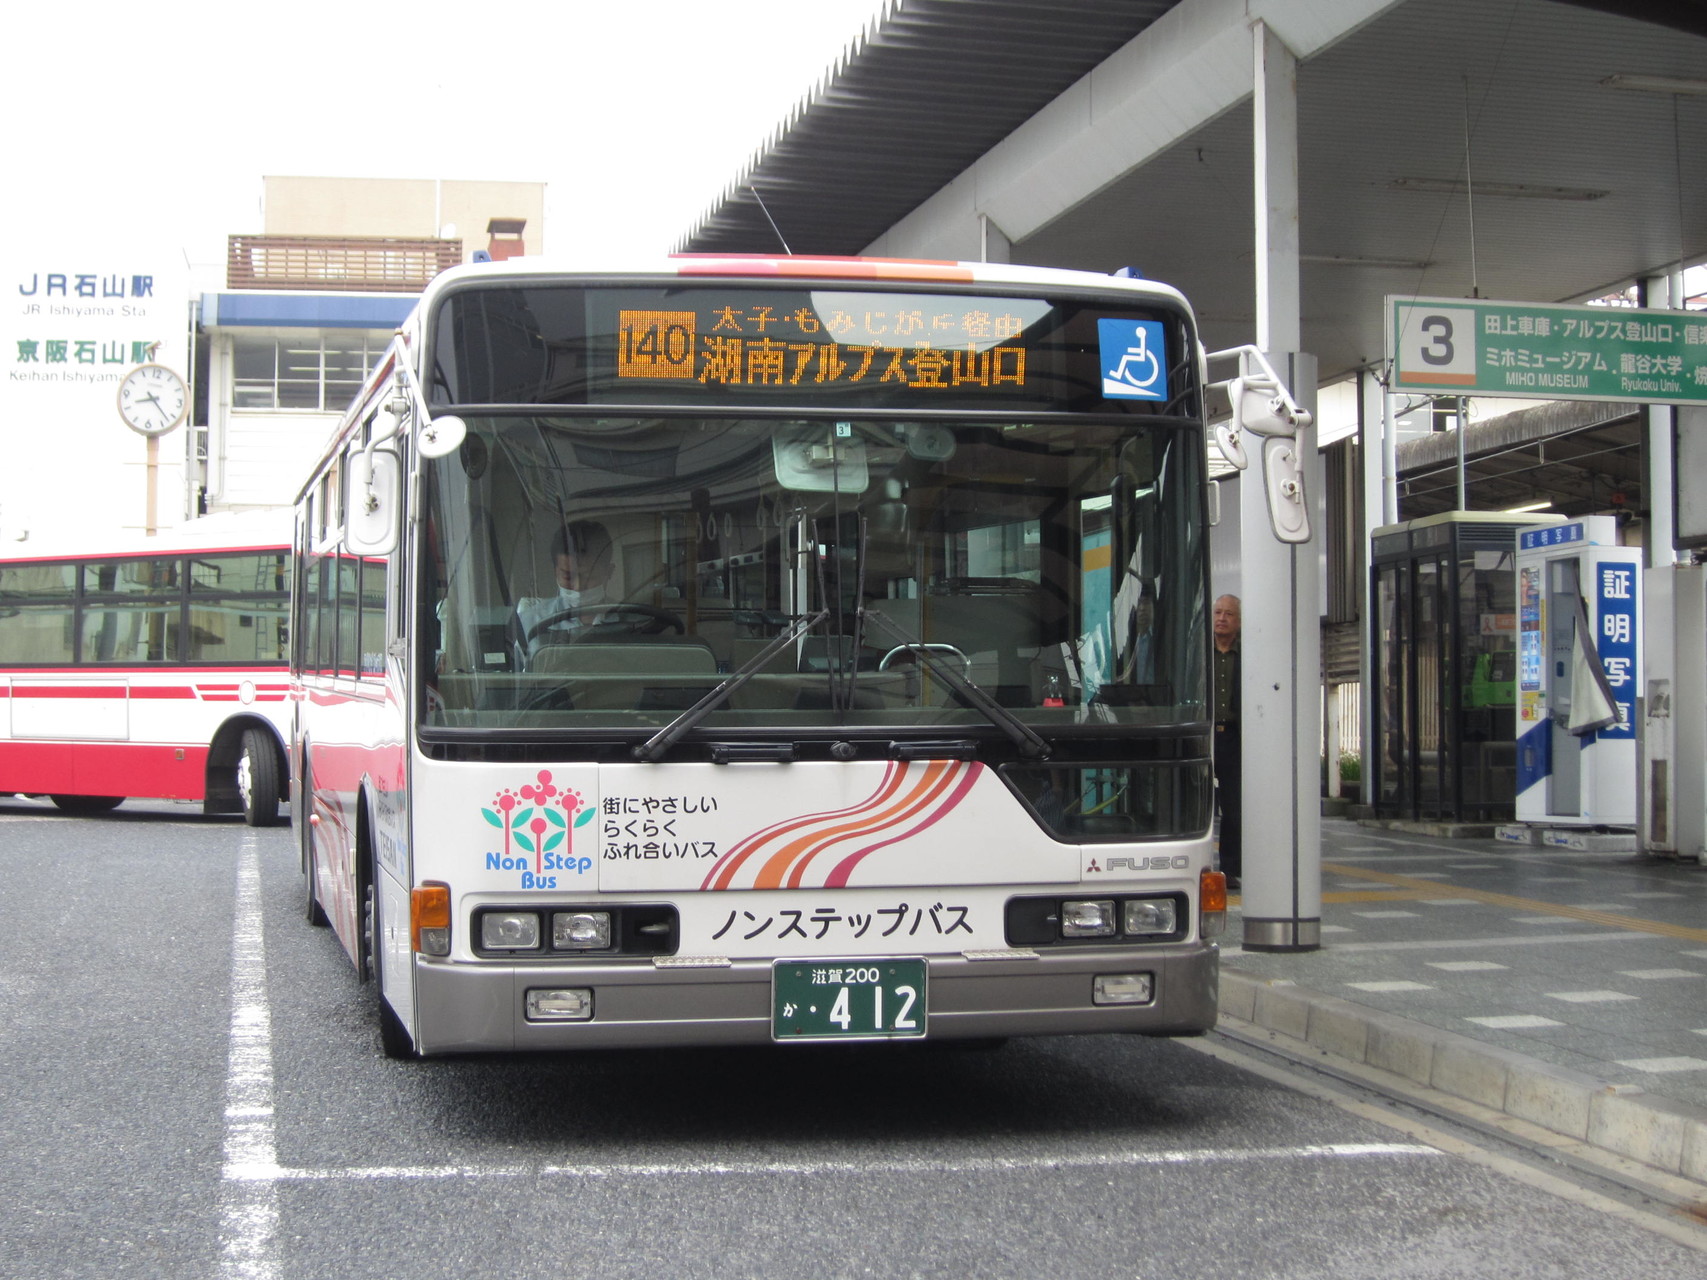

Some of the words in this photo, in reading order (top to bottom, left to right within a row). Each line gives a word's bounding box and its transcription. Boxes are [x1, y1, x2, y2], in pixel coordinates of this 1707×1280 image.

[19, 273, 153, 298] JR石山駅
[22, 304, 41, 316] JR
[49, 304, 114, 318] Ishiyama
[121, 304, 146, 317] Sta
[623, 324, 691, 365] 140
[1420, 315, 1455, 366] 3
[698, 335, 1026, 388] 湖南アルプス登山口
[9, 370, 58, 382] Keihan
[153, 368, 162, 379] 12
[1506, 372, 1535, 386] MIHO
[1538, 373, 1589, 388] MUSEUM
[1621, 377, 1658, 392] Ryukoku
[1660, 379, 1682, 392] Univ.
[123, 389, 130, 399] 9
[176, 398, 183, 409] 3
[145, 419, 152, 429] 6
[602, 796, 718, 815] 街にやさしい
[604, 819, 676, 838] らくらく
[602, 841, 718, 860] ふれ合いバス
[486, 852, 528, 871] Non
[543, 852, 592, 875] Step
[1106, 855, 1190, 871] FUSO
[521, 871, 557, 889] Bus
[711, 902, 974, 941] ノンステップバス
